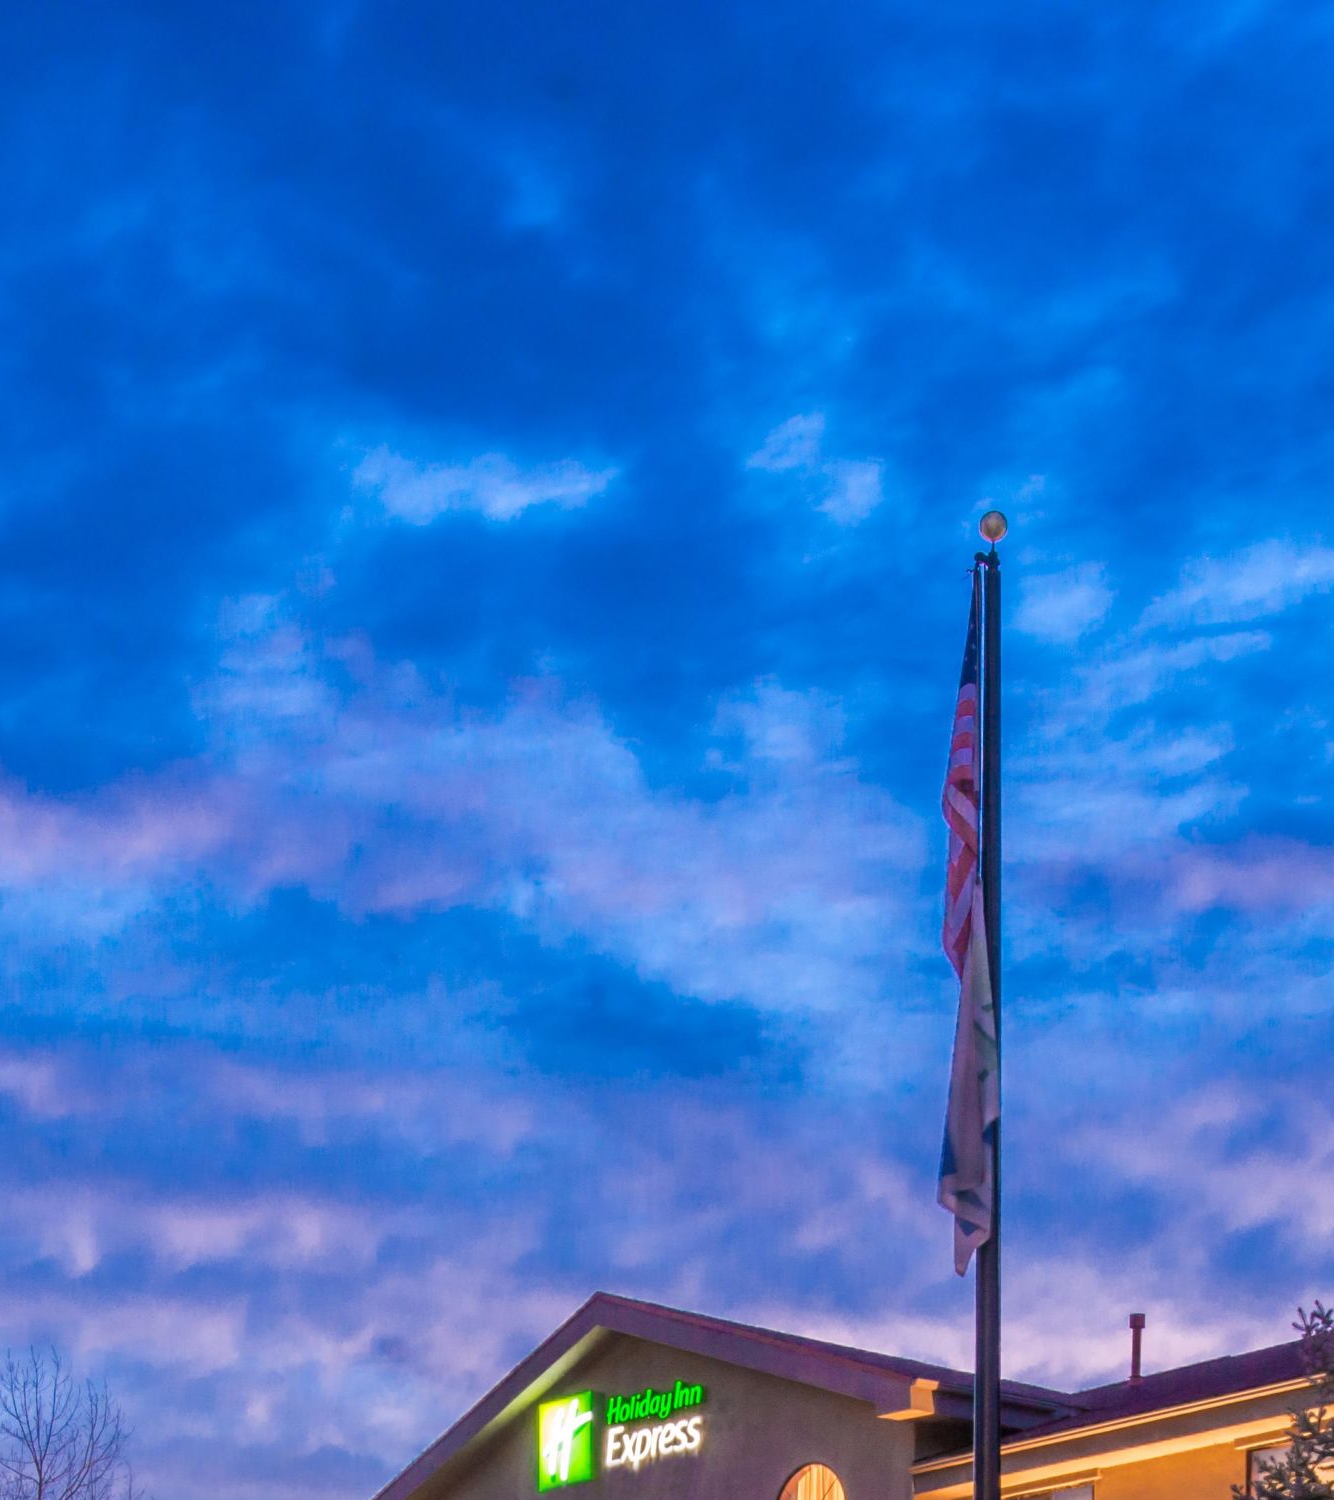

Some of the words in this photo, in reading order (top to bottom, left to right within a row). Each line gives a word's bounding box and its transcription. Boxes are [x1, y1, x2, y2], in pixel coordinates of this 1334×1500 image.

[606, 1388, 673, 1424] Holiday
[674, 1380, 703, 1408] Inn
[605, 1416, 703, 1469] Express
